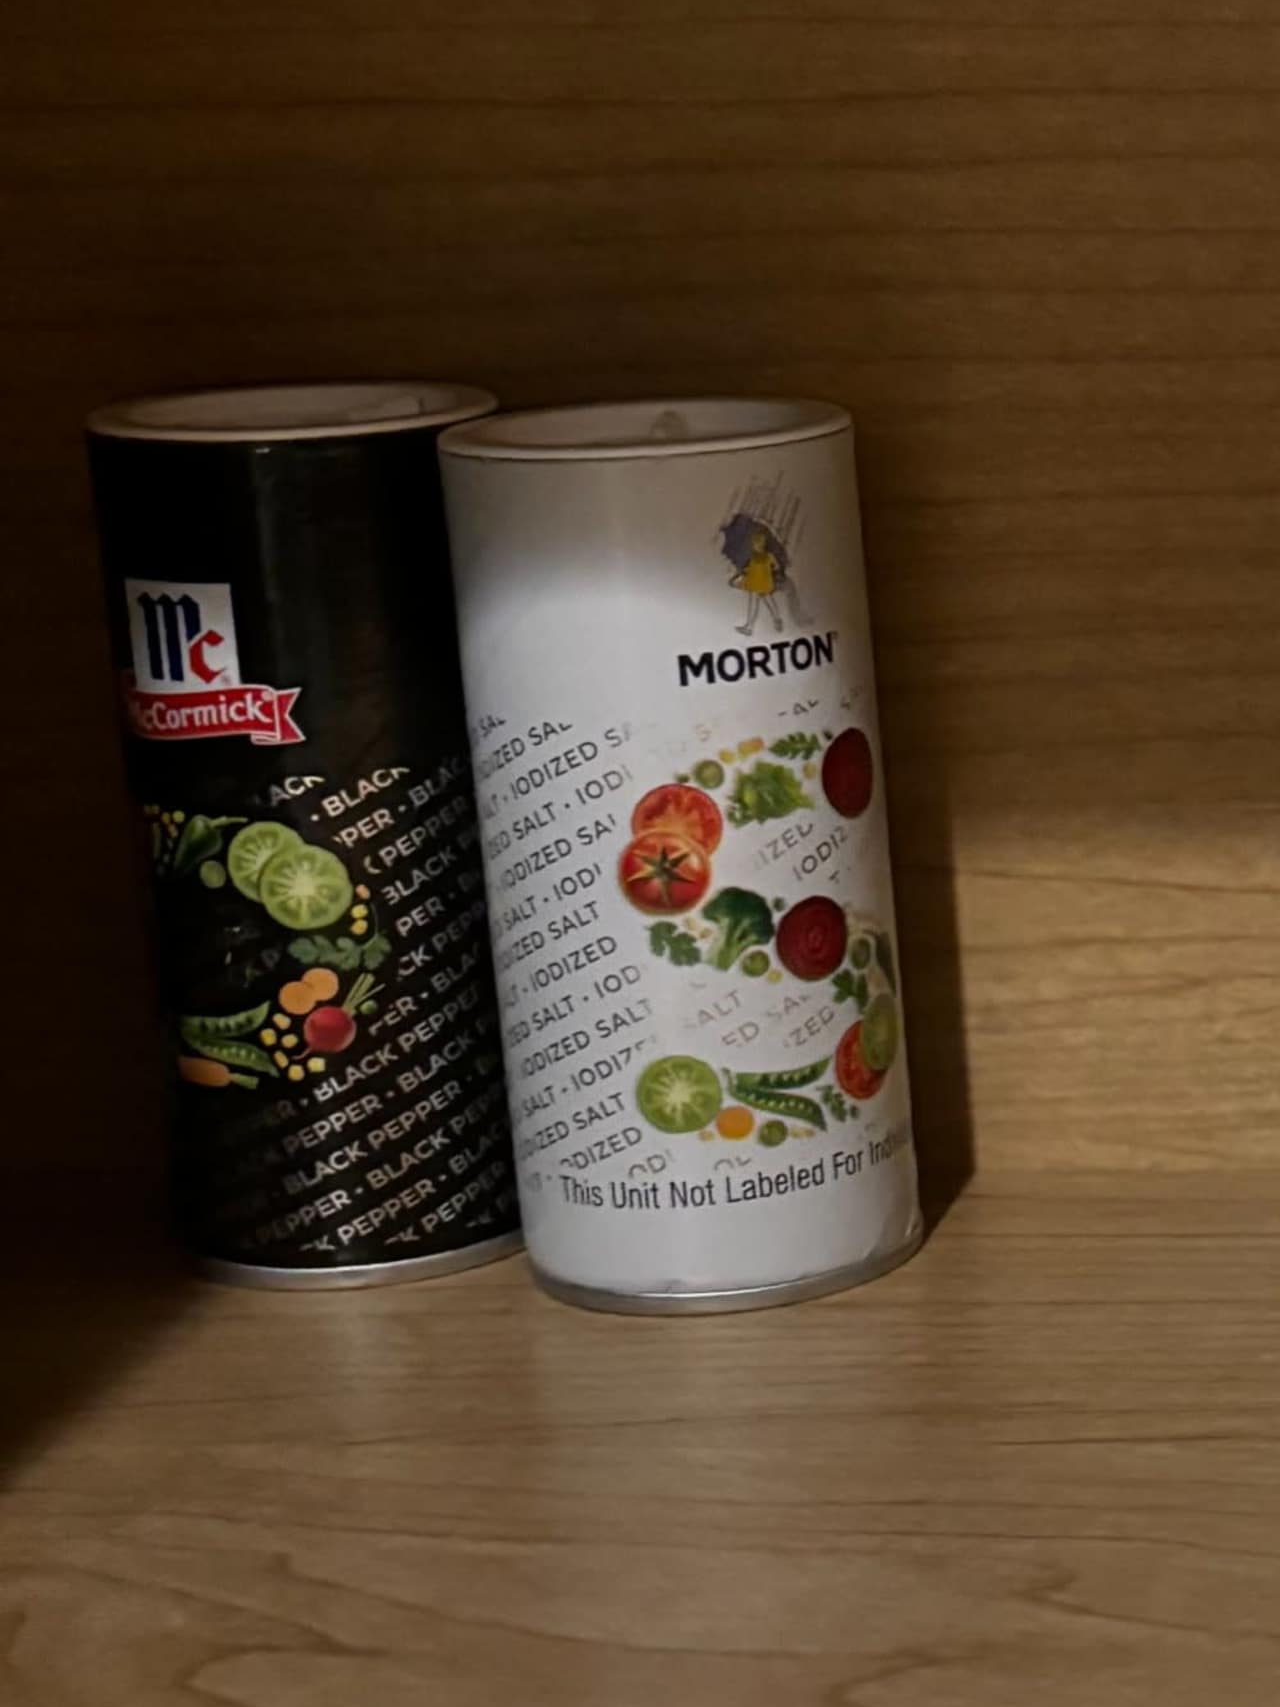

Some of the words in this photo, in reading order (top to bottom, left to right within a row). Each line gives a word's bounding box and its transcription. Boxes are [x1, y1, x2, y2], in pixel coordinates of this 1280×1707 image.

[678, 632, 835, 686] MORTON
[511, 741, 599, 800] IODIZED
[512, 801, 556, 841] SALT
[500, 838, 572, 889] ODIZED
[503, 895, 537, 932] SALT
[547, 900, 600, 941] SALT
[530, 936, 618, 993] IODIZED
[520, 1030, 590, 1079] ODIZED
[595, 998, 653, 1040] SALT
[531, 995, 575, 1032] SALT
[282, 1093, 383, 1156] PEPPER
[366, 1080, 463, 1150] PEPPER
[572, 1092, 625, 1132] SALT
[365, 1127, 451, 1190] BLACK
[560, 1175, 603, 1207] This
[611, 1181, 660, 1209] Unit
[670, 1180, 716, 1208] Not
[726, 1159, 825, 1203] Labeled
[833, 1151, 863, 1180] For
[337, 1178, 437, 1246] PEPPER
